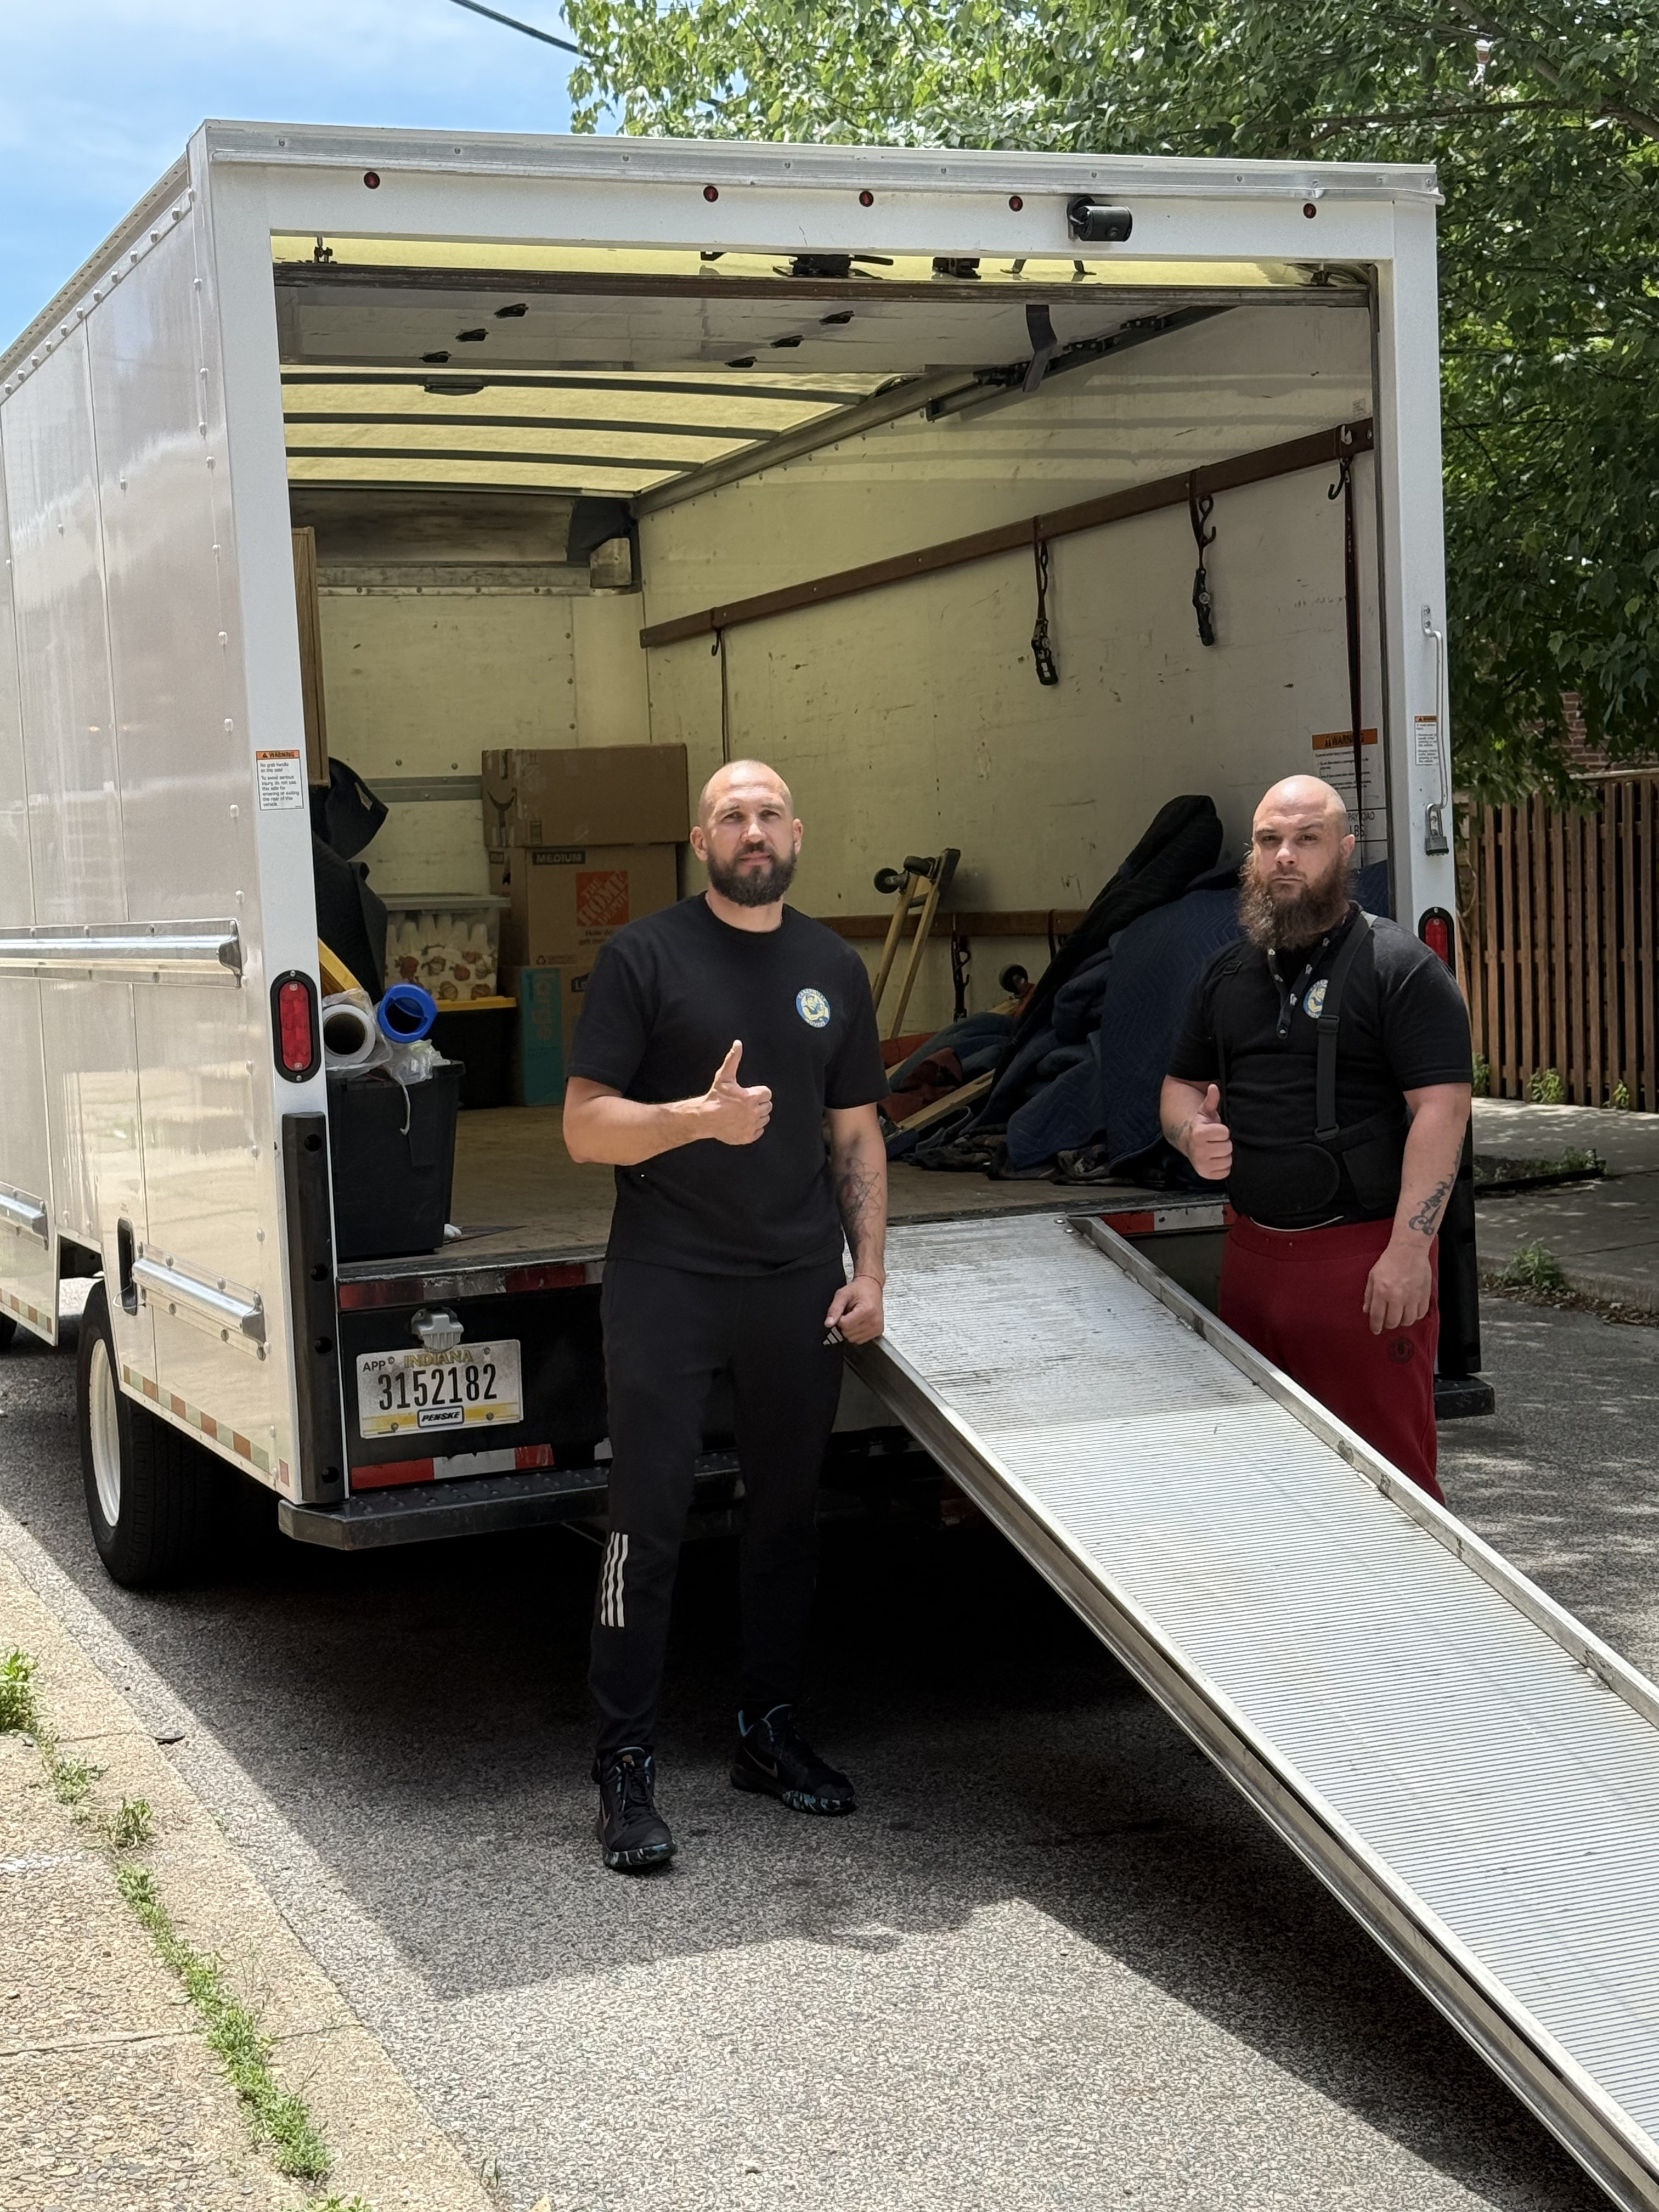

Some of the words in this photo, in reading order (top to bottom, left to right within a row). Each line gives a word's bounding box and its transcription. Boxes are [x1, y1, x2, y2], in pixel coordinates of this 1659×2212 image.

[1331, 733, 1364, 746] WARNG
[1347, 811, 1375, 821] PAYOAD
[536, 853, 582, 864] MEDIUM
[580, 877, 601, 900] THE
[577, 871, 628, 926] HOME
[597, 888, 628, 926] DEPOT
[531, 973, 556, 1041] large
[362, 1361, 386, 1372] APP
[404, 1350, 473, 1368] INDIANA
[379, 1363, 497, 1410] 3152182
[421, 1411, 460, 1422] PENSKE
